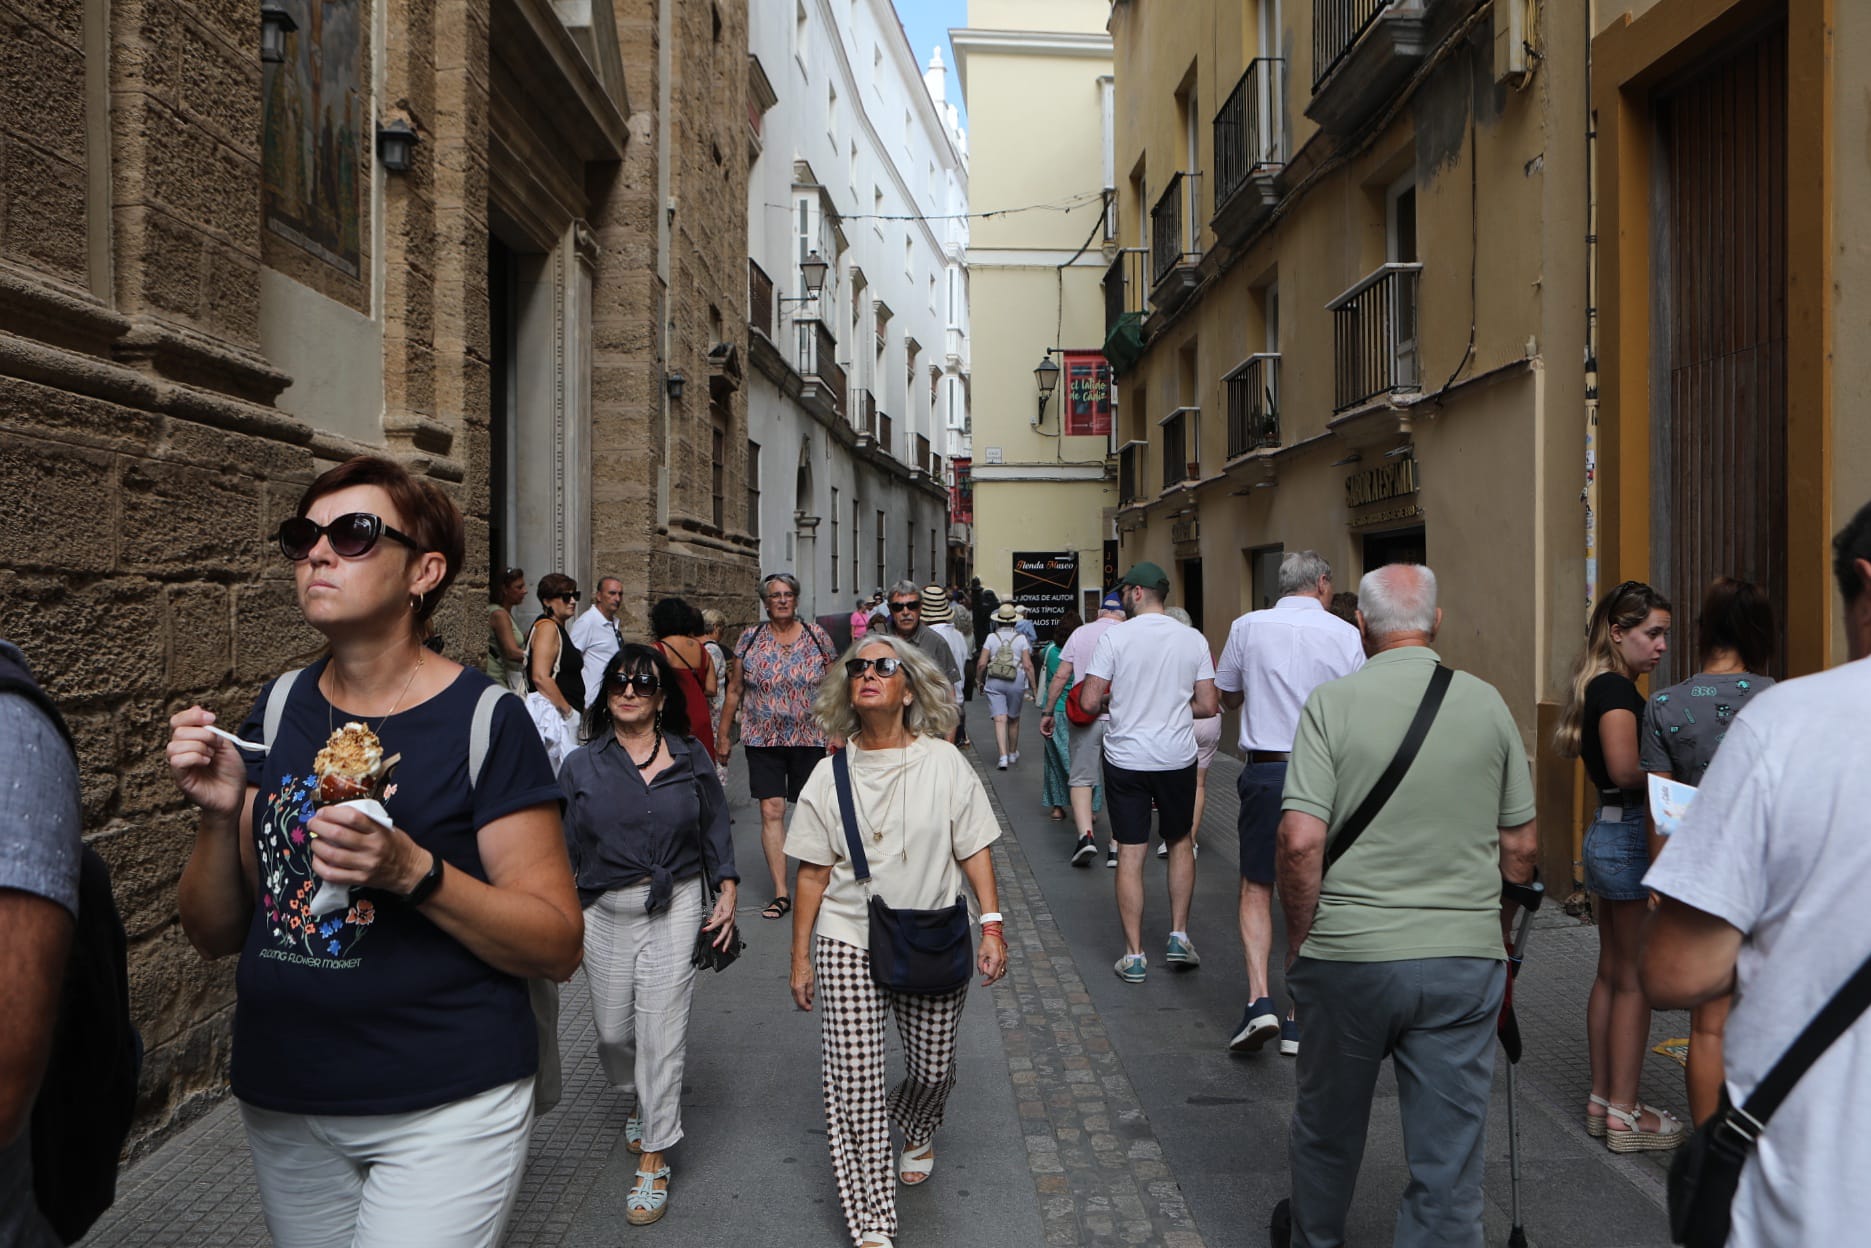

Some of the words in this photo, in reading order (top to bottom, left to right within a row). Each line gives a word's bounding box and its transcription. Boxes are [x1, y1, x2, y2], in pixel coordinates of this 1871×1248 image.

[1081, 378, 1106, 391] latido
[1017, 560, 1044, 570] Tienda
[1047, 560, 1073, 570] Museo
[1105, 551, 1113, 588] JOY
[1691, 686, 1717, 697] BRO
